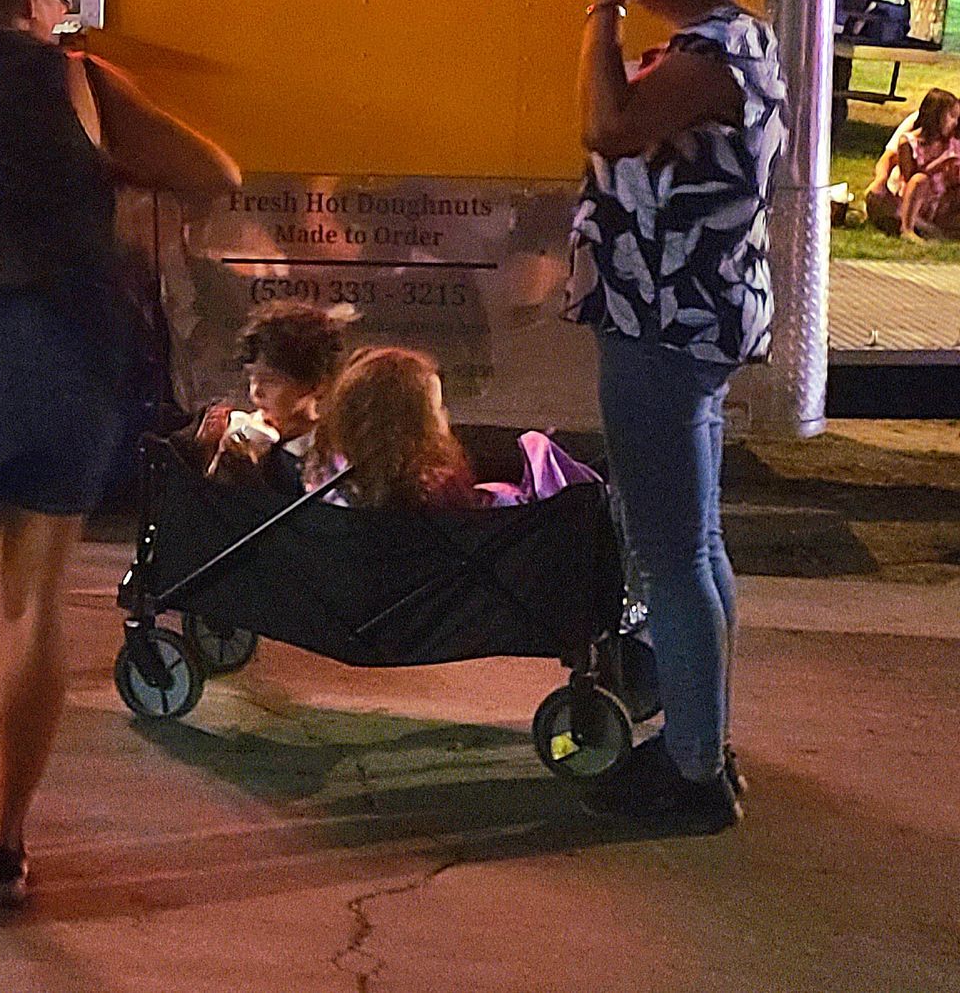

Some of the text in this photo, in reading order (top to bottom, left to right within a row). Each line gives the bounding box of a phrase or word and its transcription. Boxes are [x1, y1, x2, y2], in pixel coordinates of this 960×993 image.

[228, 190, 493, 221] Fresh Hot Doughnuts
[275, 224, 444, 247] Made to Order
